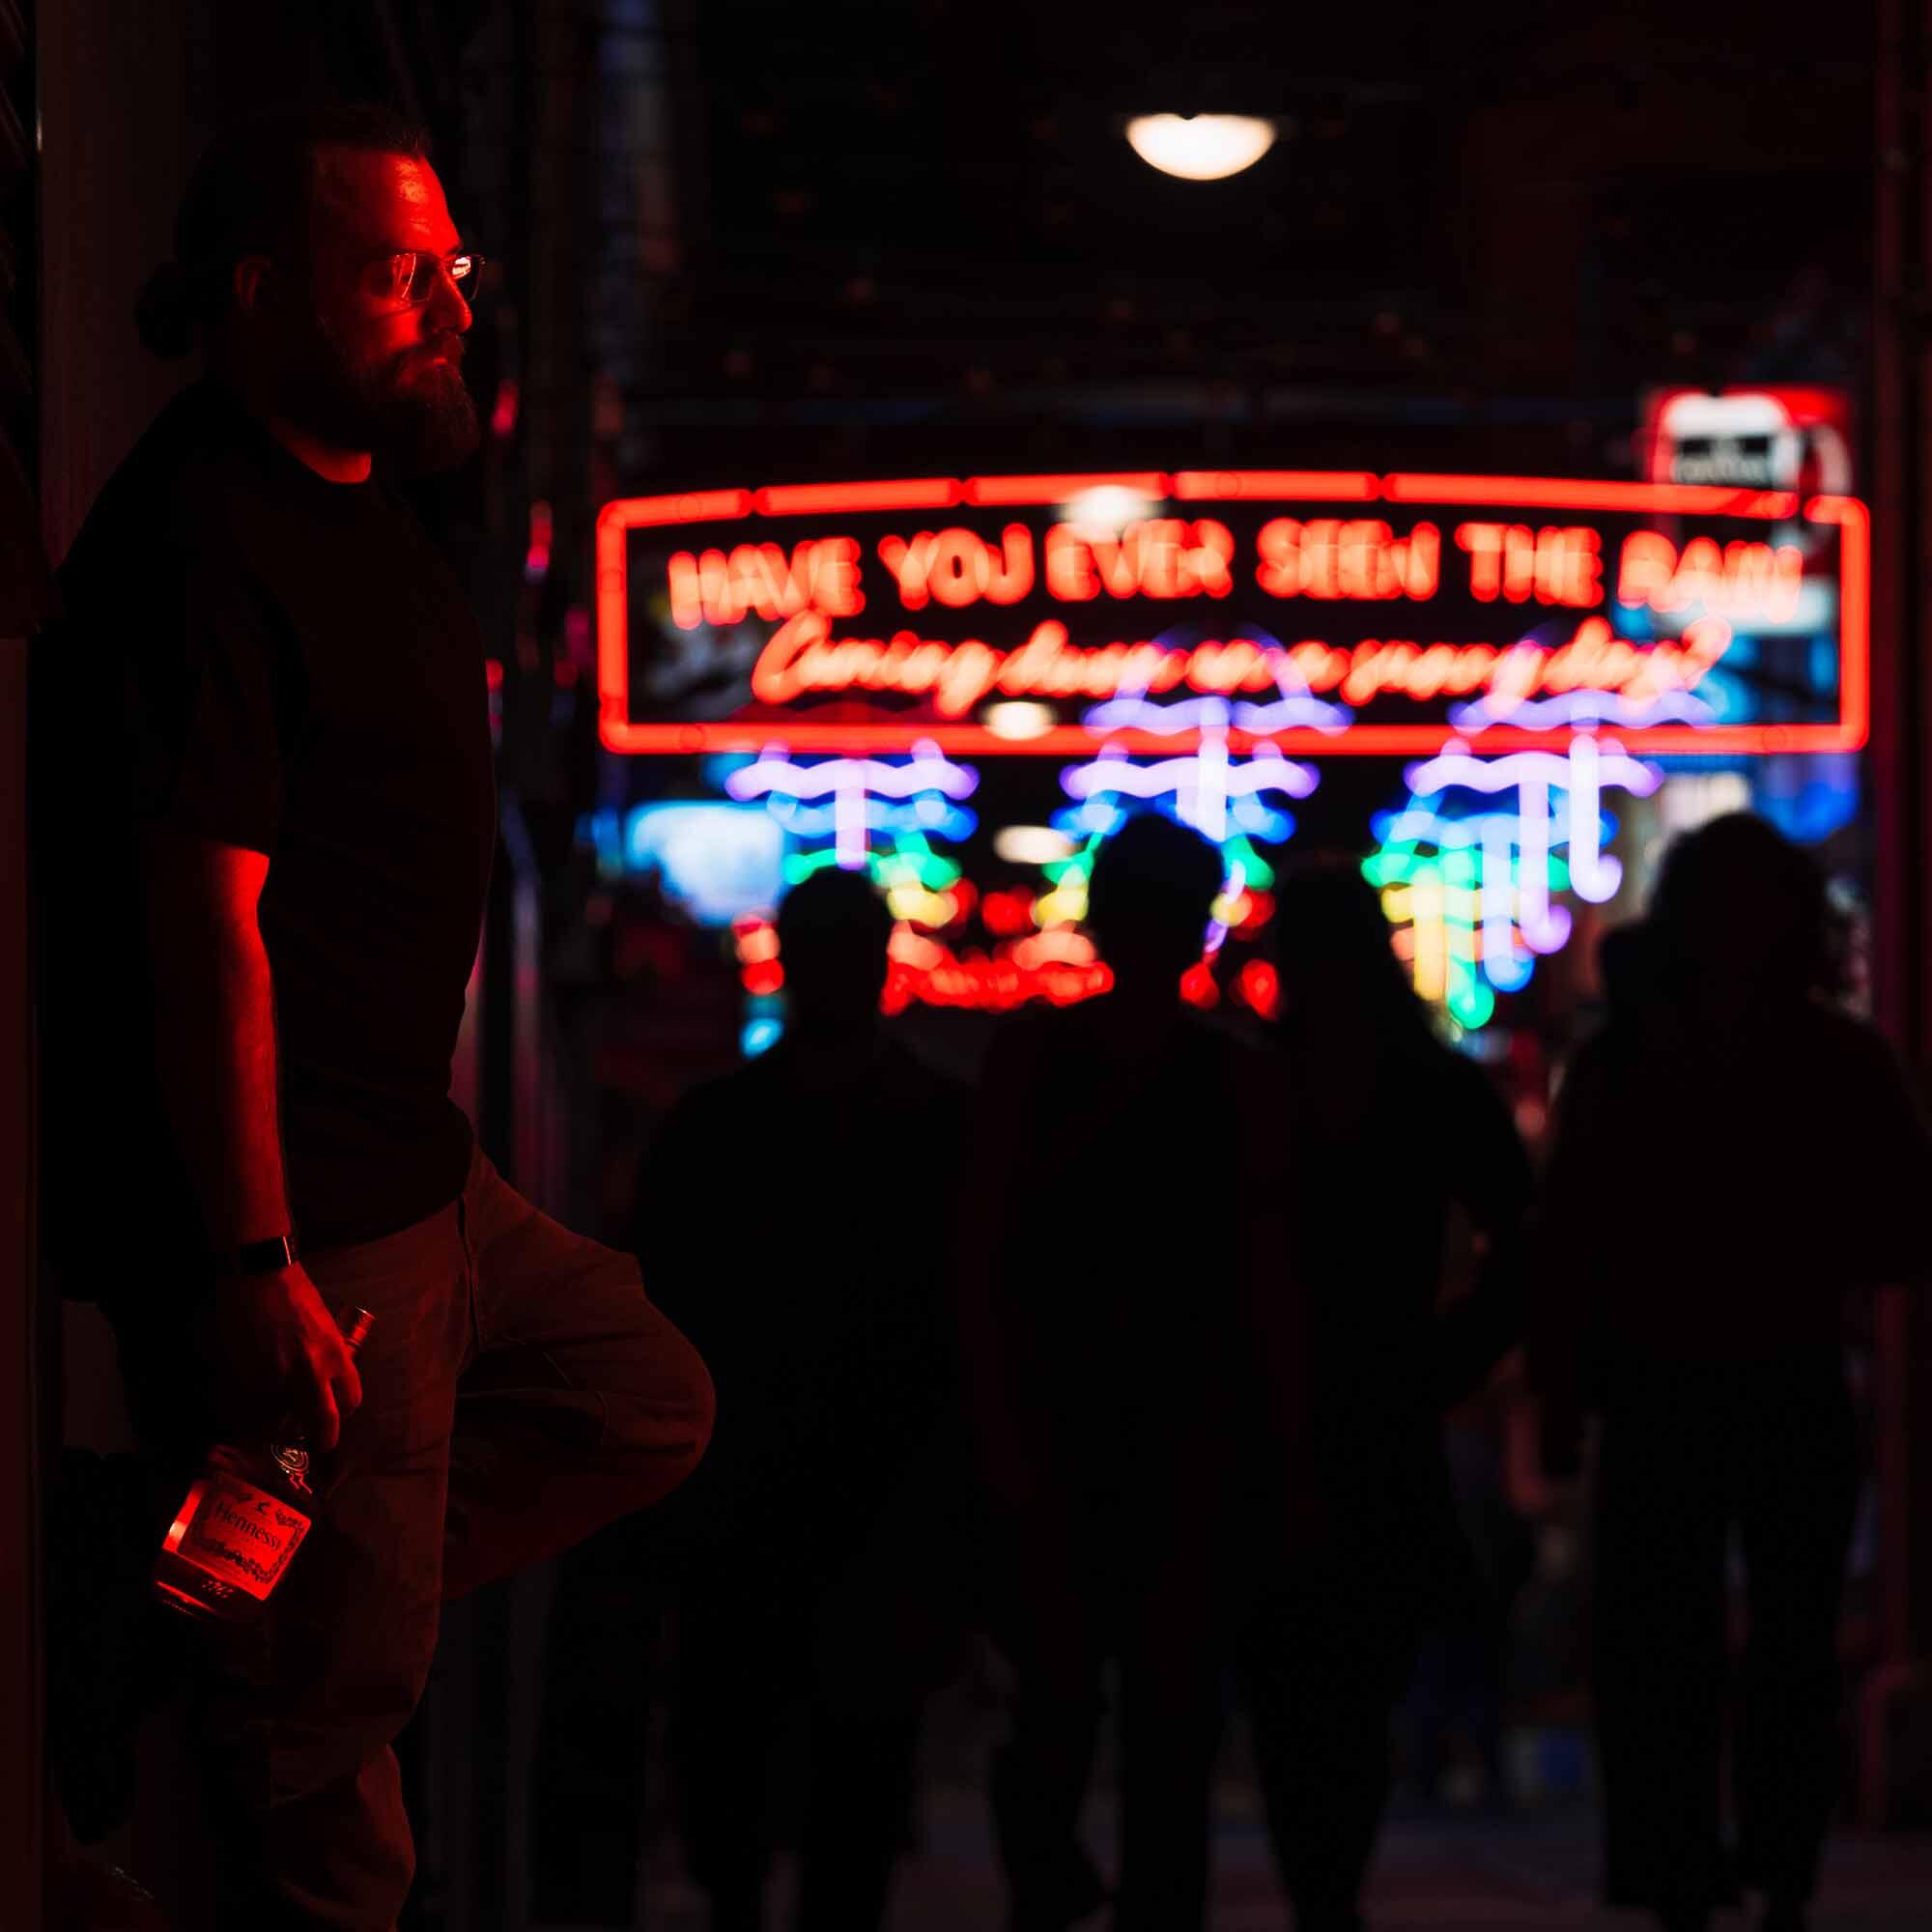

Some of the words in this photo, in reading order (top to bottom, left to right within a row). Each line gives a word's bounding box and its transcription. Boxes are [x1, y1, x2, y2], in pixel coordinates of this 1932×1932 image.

[668, 536, 866, 629] HAVE
[878, 523, 1034, 611] YOU
[1045, 518, 1235, 602] EVER
[1256, 518, 1439, 601] SEEN
[1455, 523, 1603, 608] THE
